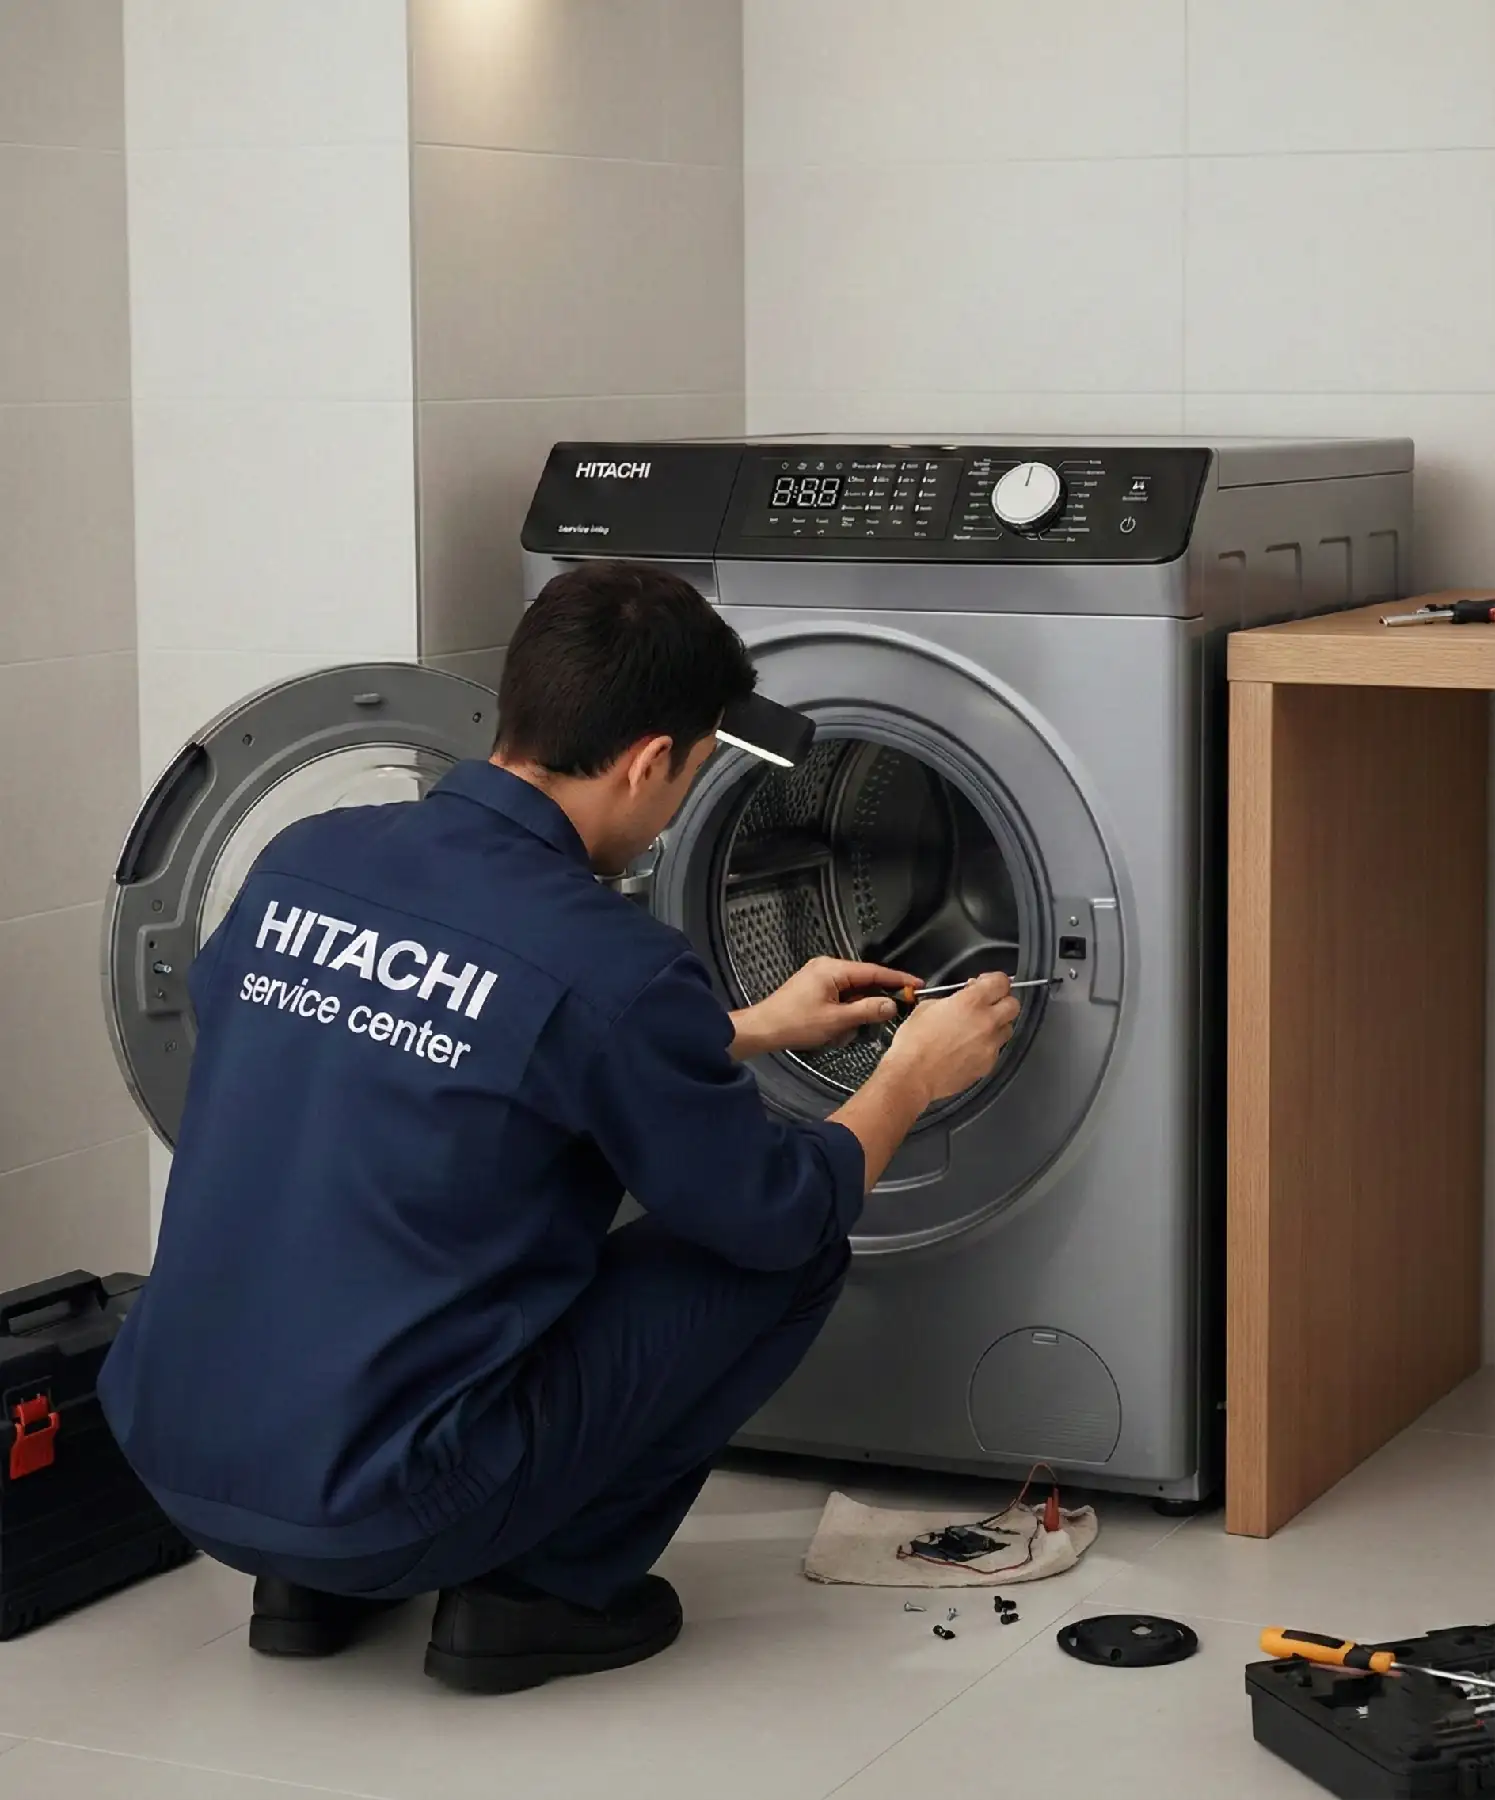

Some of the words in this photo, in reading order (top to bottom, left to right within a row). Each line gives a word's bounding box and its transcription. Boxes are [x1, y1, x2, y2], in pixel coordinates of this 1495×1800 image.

[575, 462, 652, 479] HITACHI
[255, 900, 499, 1021] HITACHI
[239, 972, 341, 1024] service
[347, 1005, 472, 1069] center
